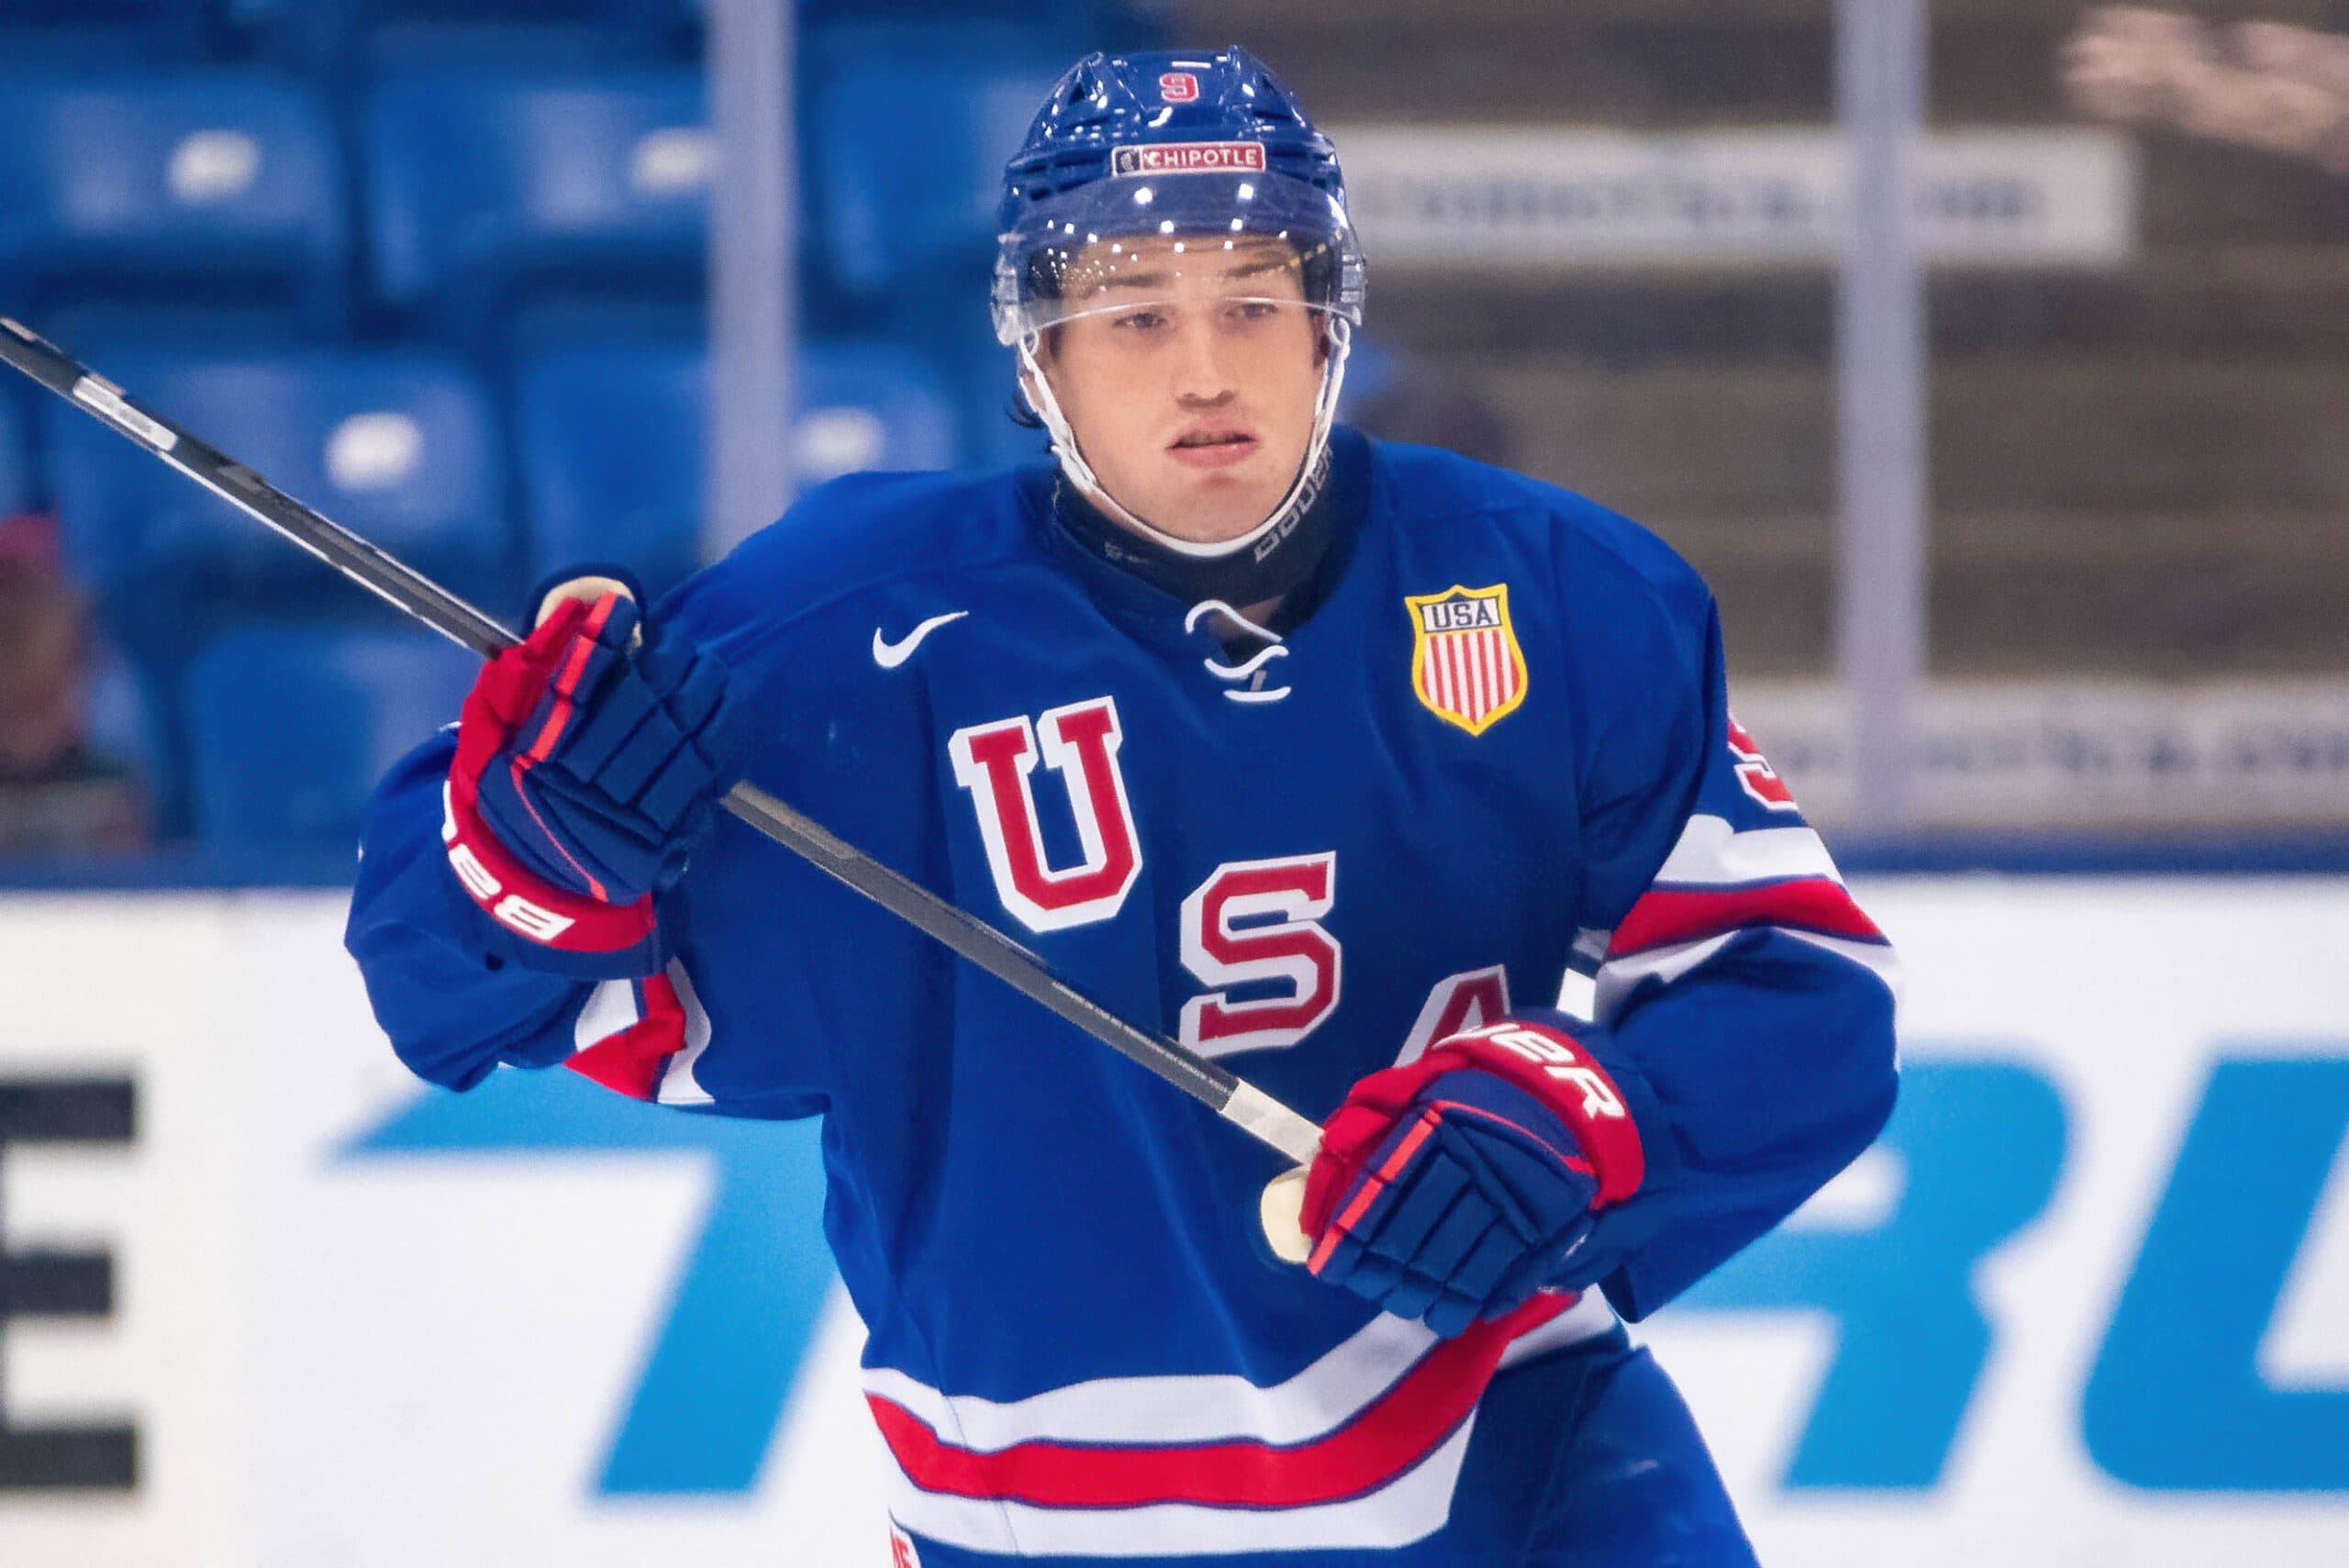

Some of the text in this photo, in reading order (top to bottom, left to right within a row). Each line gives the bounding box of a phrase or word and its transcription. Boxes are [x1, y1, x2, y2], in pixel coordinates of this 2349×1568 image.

[1159, 72, 1199, 103] 9
[1146, 149, 1257, 167] CHIPOTLE
[1431, 600, 1493, 628] USA
